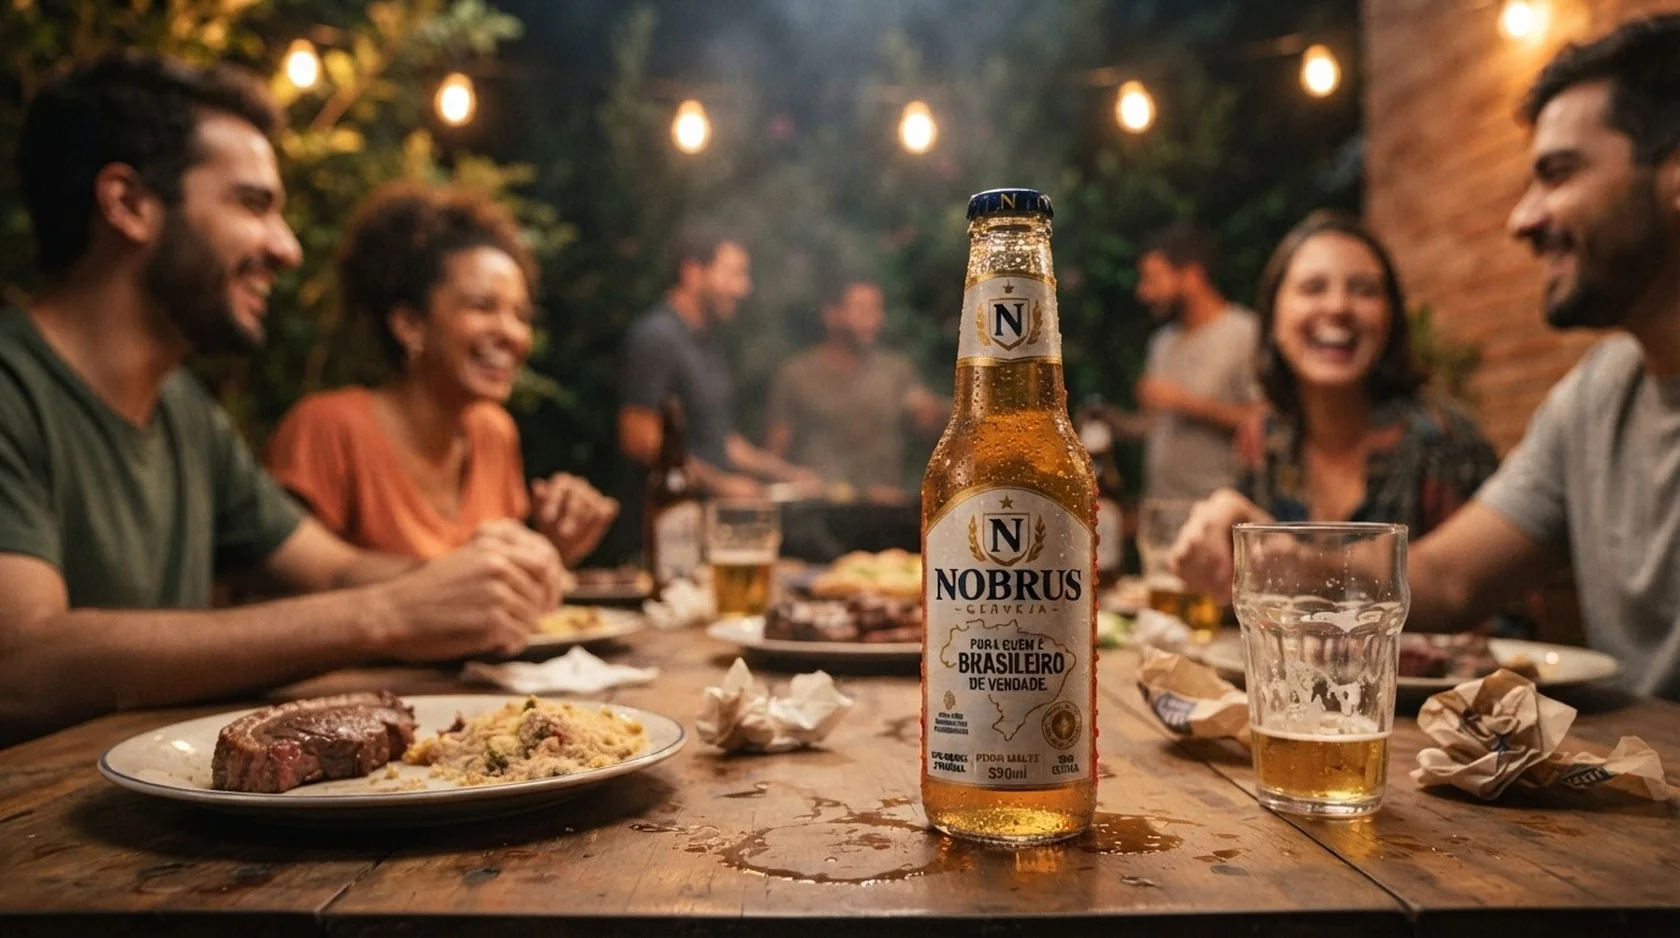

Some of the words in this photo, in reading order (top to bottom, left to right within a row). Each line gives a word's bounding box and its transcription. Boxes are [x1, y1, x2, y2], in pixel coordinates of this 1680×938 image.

[1000, 193, 1017, 209] N
[993, 303, 1024, 337] N
[989, 518, 1024, 553] N
[934, 568, 1082, 601] NOBRUS
[958, 652, 1064, 675] BRASILEIRO
[969, 677, 985, 691] DE
